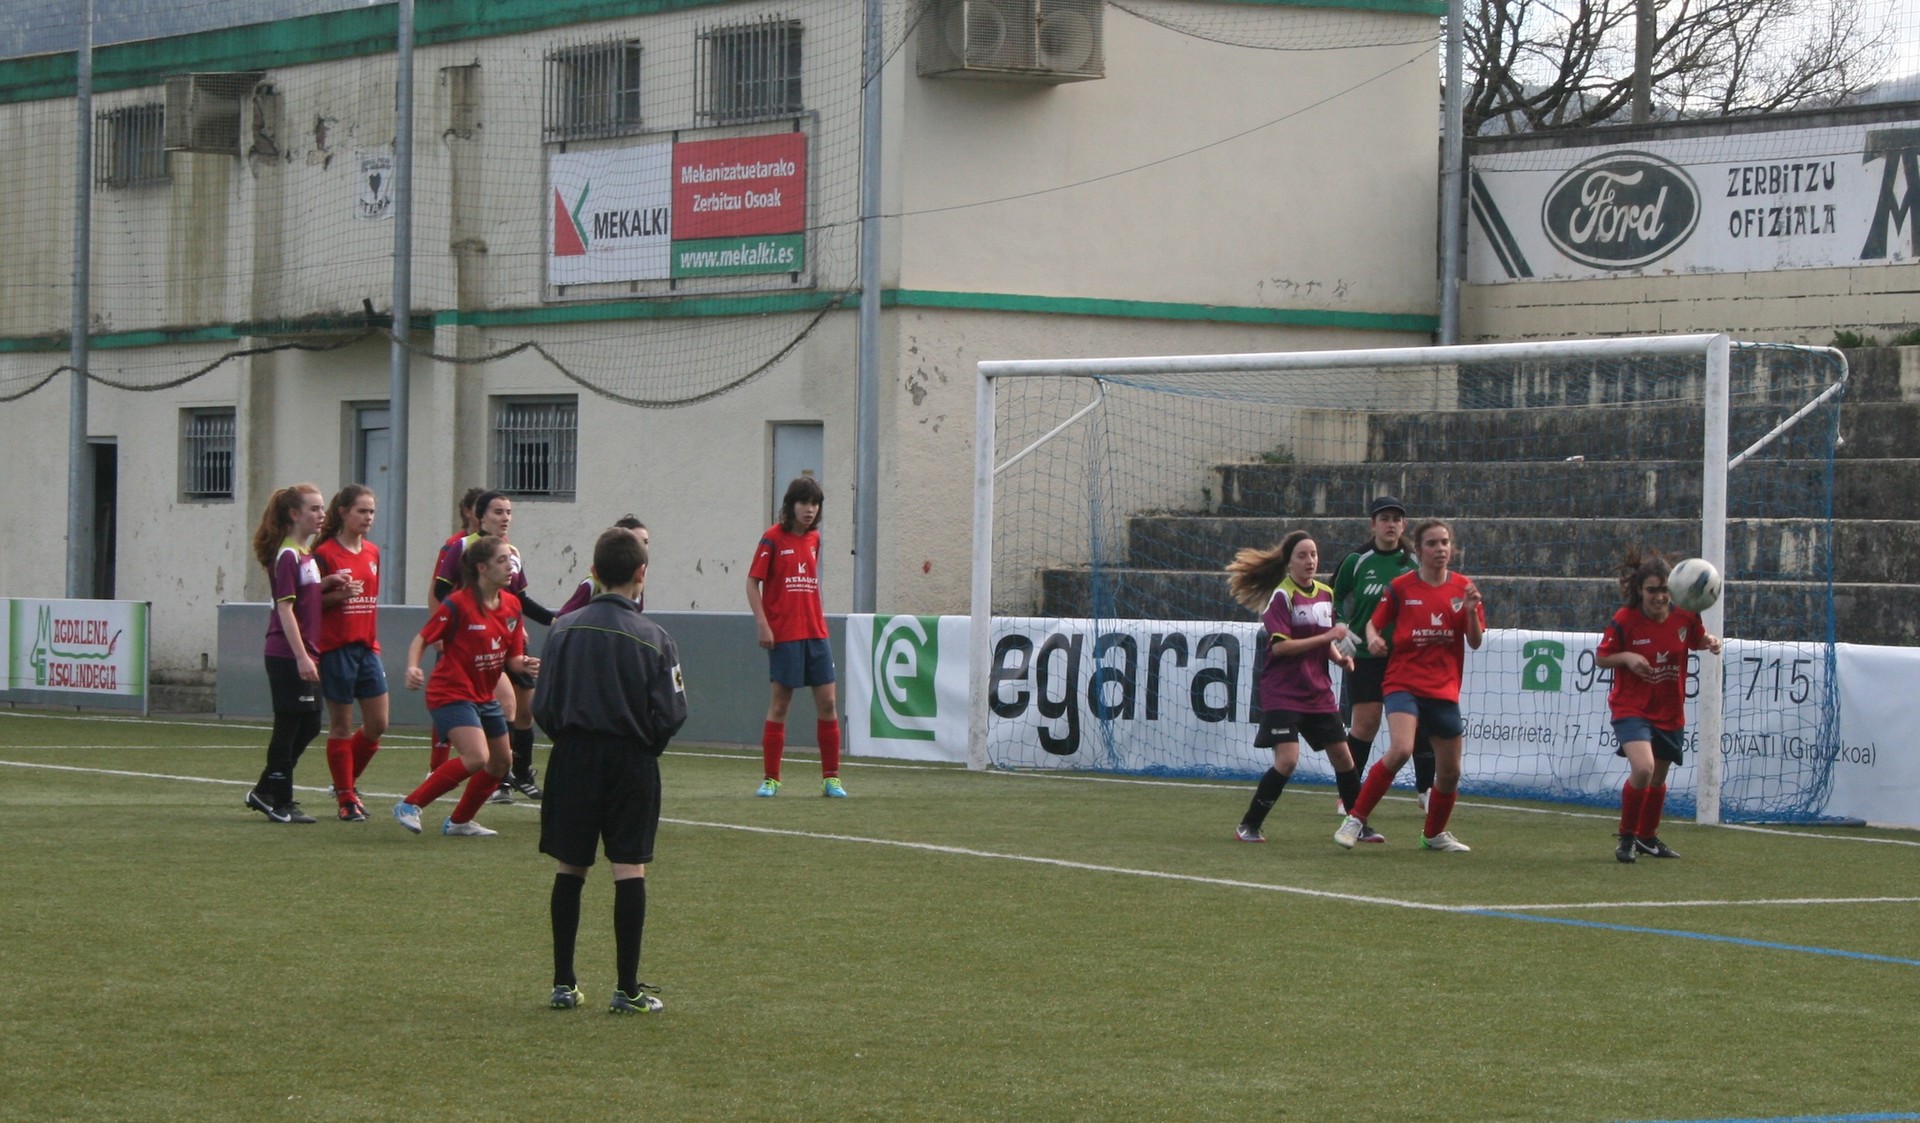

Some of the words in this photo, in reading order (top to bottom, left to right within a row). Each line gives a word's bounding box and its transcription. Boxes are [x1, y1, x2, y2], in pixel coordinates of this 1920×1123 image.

[681, 158, 795, 184] Mekanizatuetarako
[693, 193, 741, 213] Zerbitzu
[744, 188, 782, 208] Osoak
[1569, 170, 1669, 244] Ford
[594, 207, 668, 240] MEKALKI
[681, 242, 794, 269] www.mekalki.es
[1743, 657, 1811, 704] 715
[1564, 724, 1581, 744] 17
[1783, 734, 1876, 767] (Gipuzkoa)
